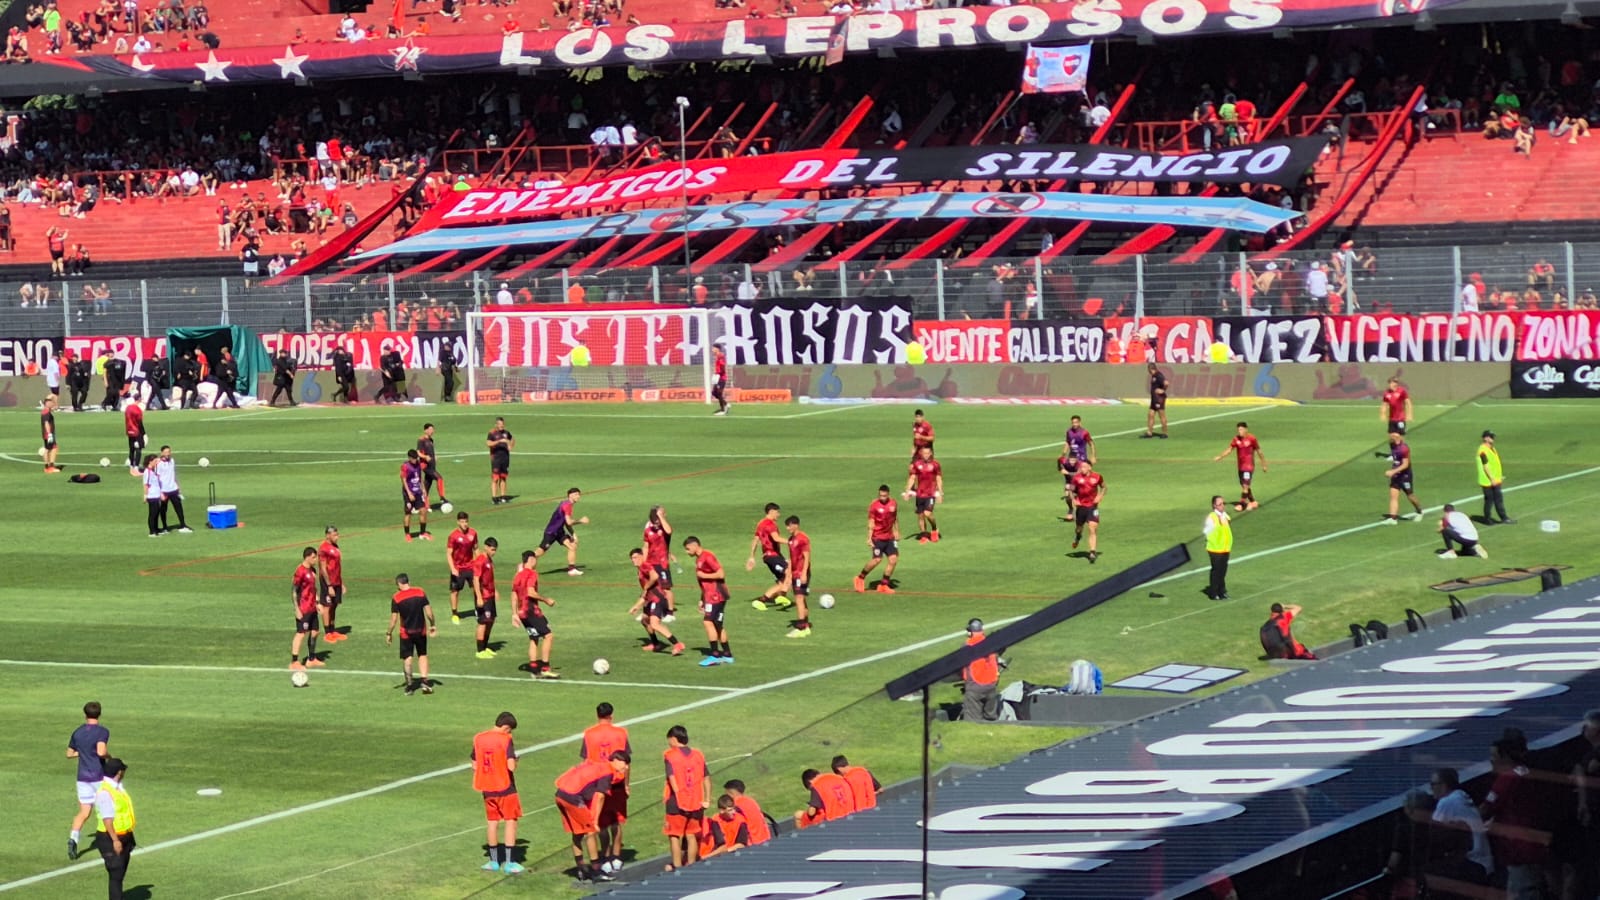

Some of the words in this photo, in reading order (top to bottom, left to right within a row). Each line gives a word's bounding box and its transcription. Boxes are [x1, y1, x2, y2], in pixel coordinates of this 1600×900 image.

[500, 24, 675, 65] LOS
[722, 0, 1283, 55] LEPROSOS
[446, 166, 727, 219] ENEMIGOS
[780, 156, 899, 184] DEL
[966, 145, 1291, 178] SILENCIO
[1008, 325, 1104, 363] GALLEGO
[1523, 313, 1594, 361] ZONA
